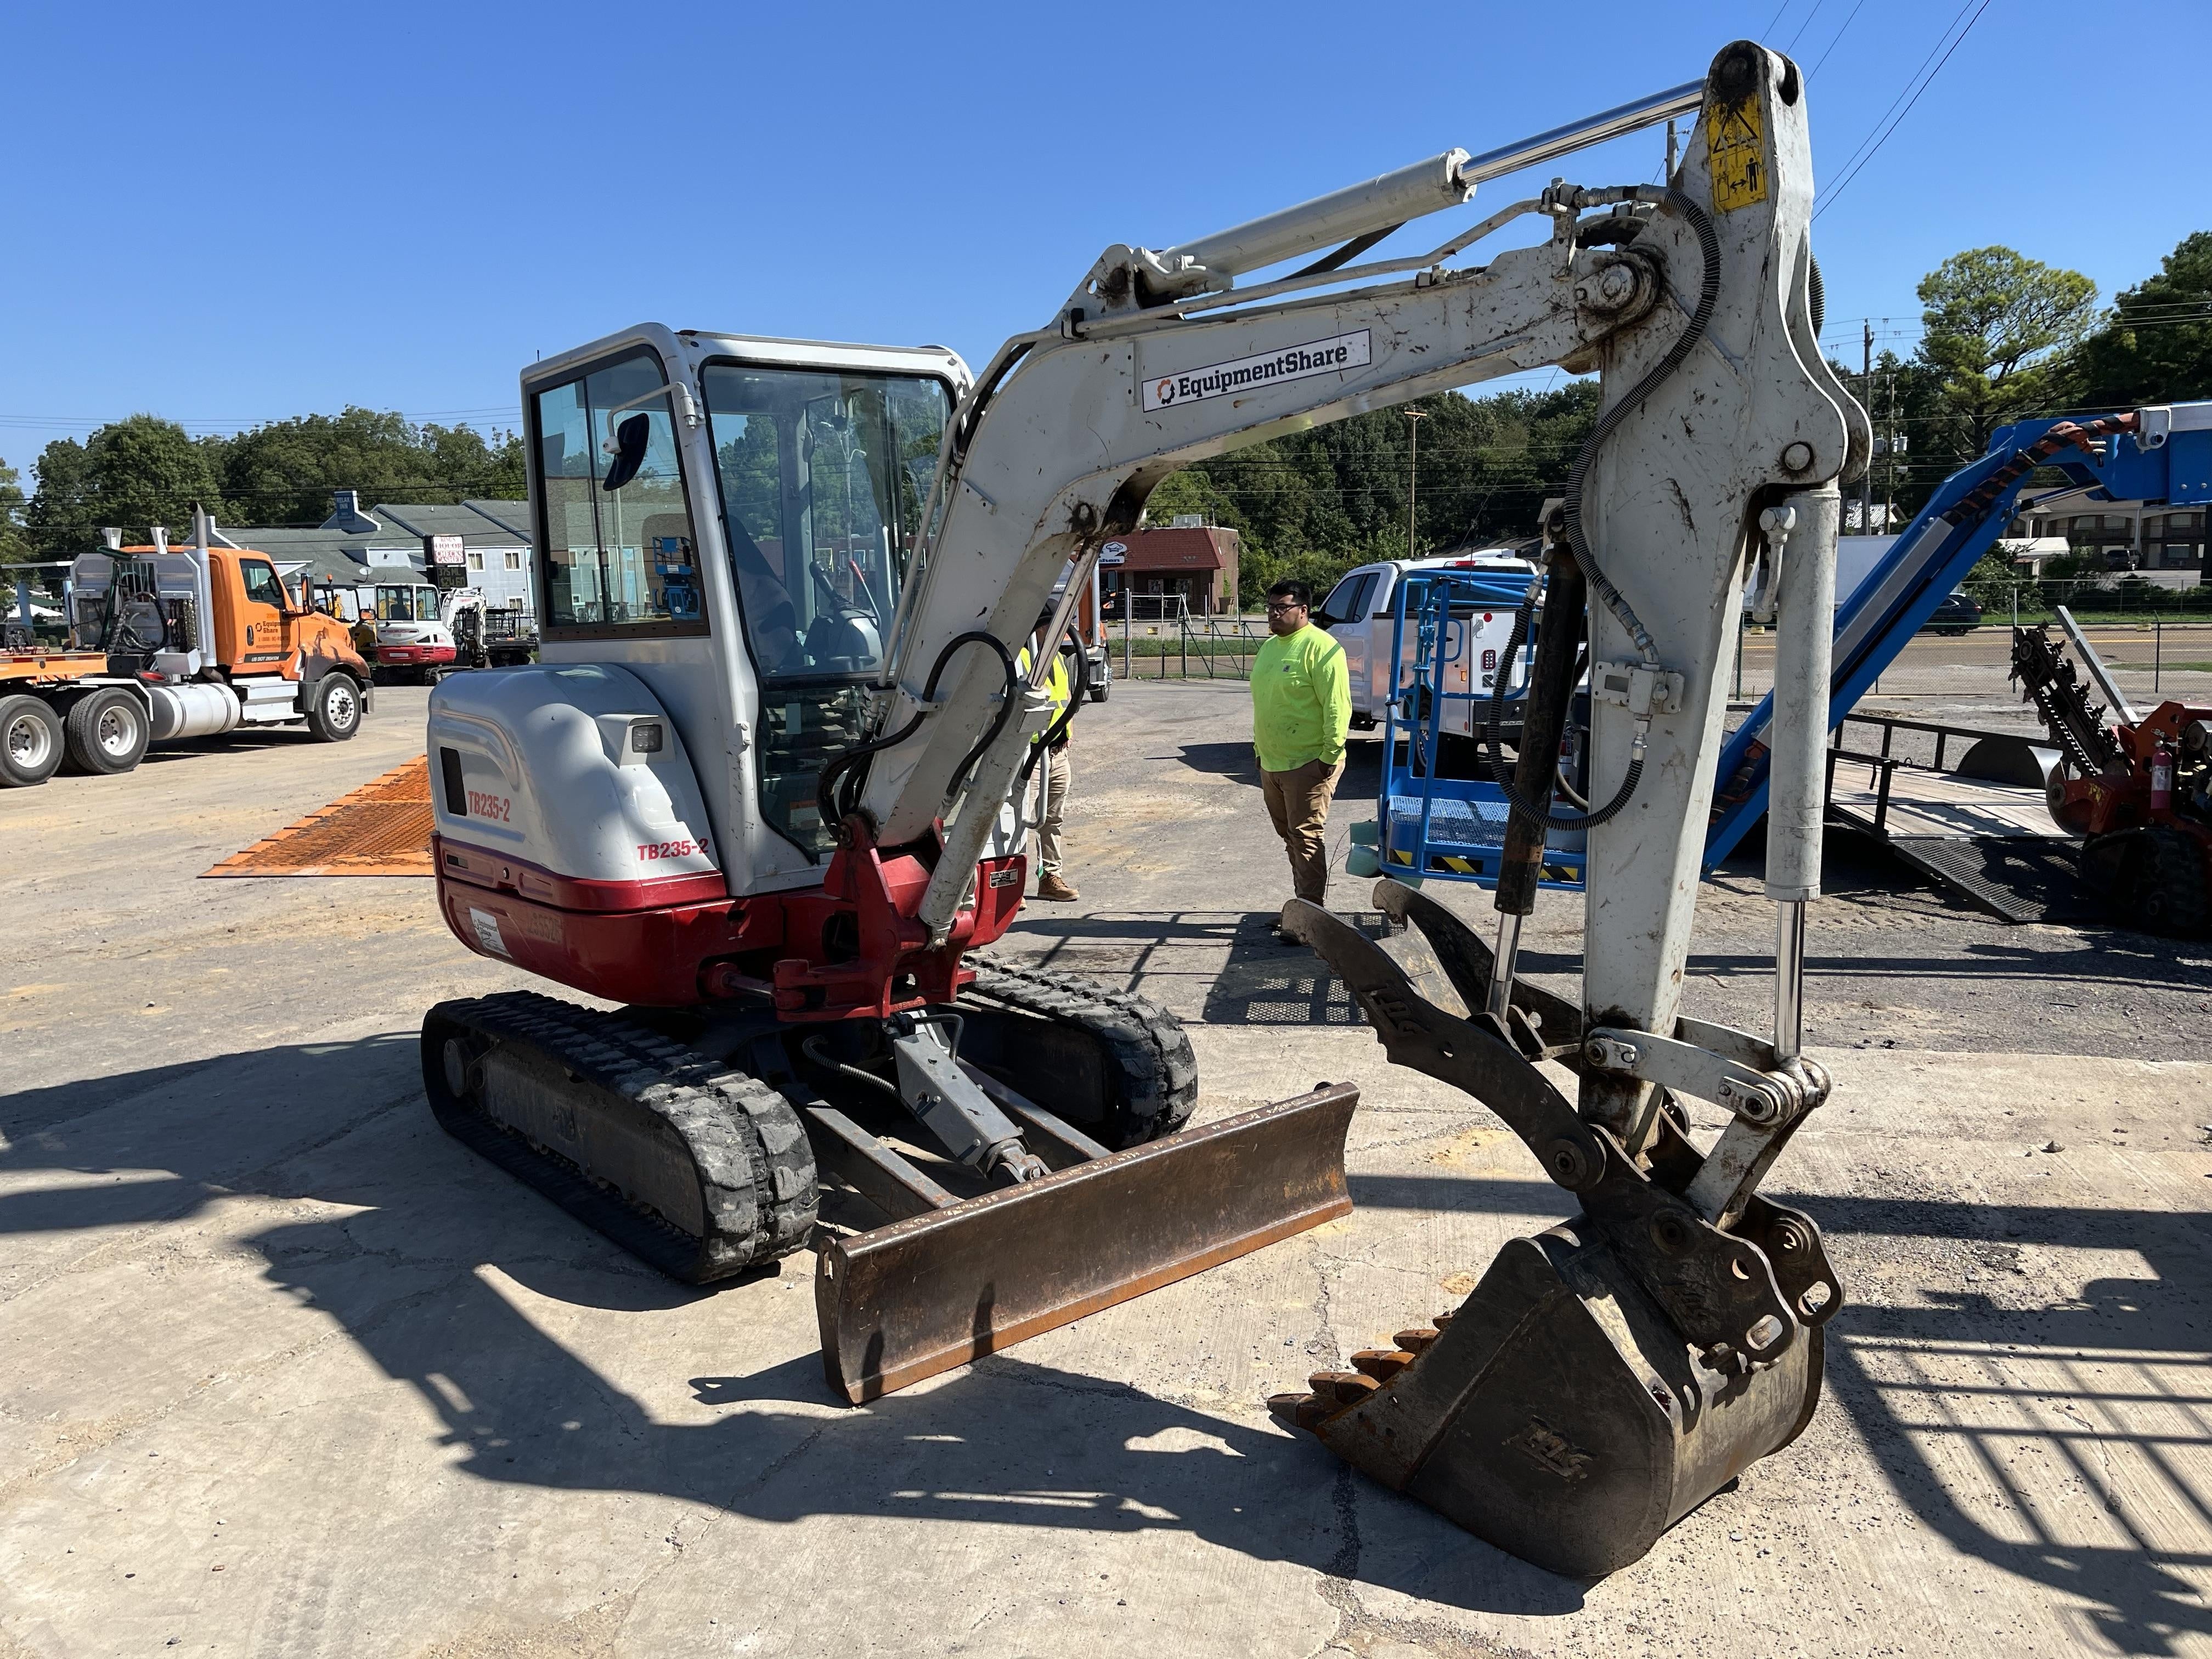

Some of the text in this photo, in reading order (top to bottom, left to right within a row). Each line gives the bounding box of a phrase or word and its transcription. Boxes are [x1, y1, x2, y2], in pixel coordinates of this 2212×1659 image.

[1178, 346, 1347, 398] EquipmentShare
[468, 791, 510, 822] TB235-2
[637, 838, 709, 861] TB235-2
